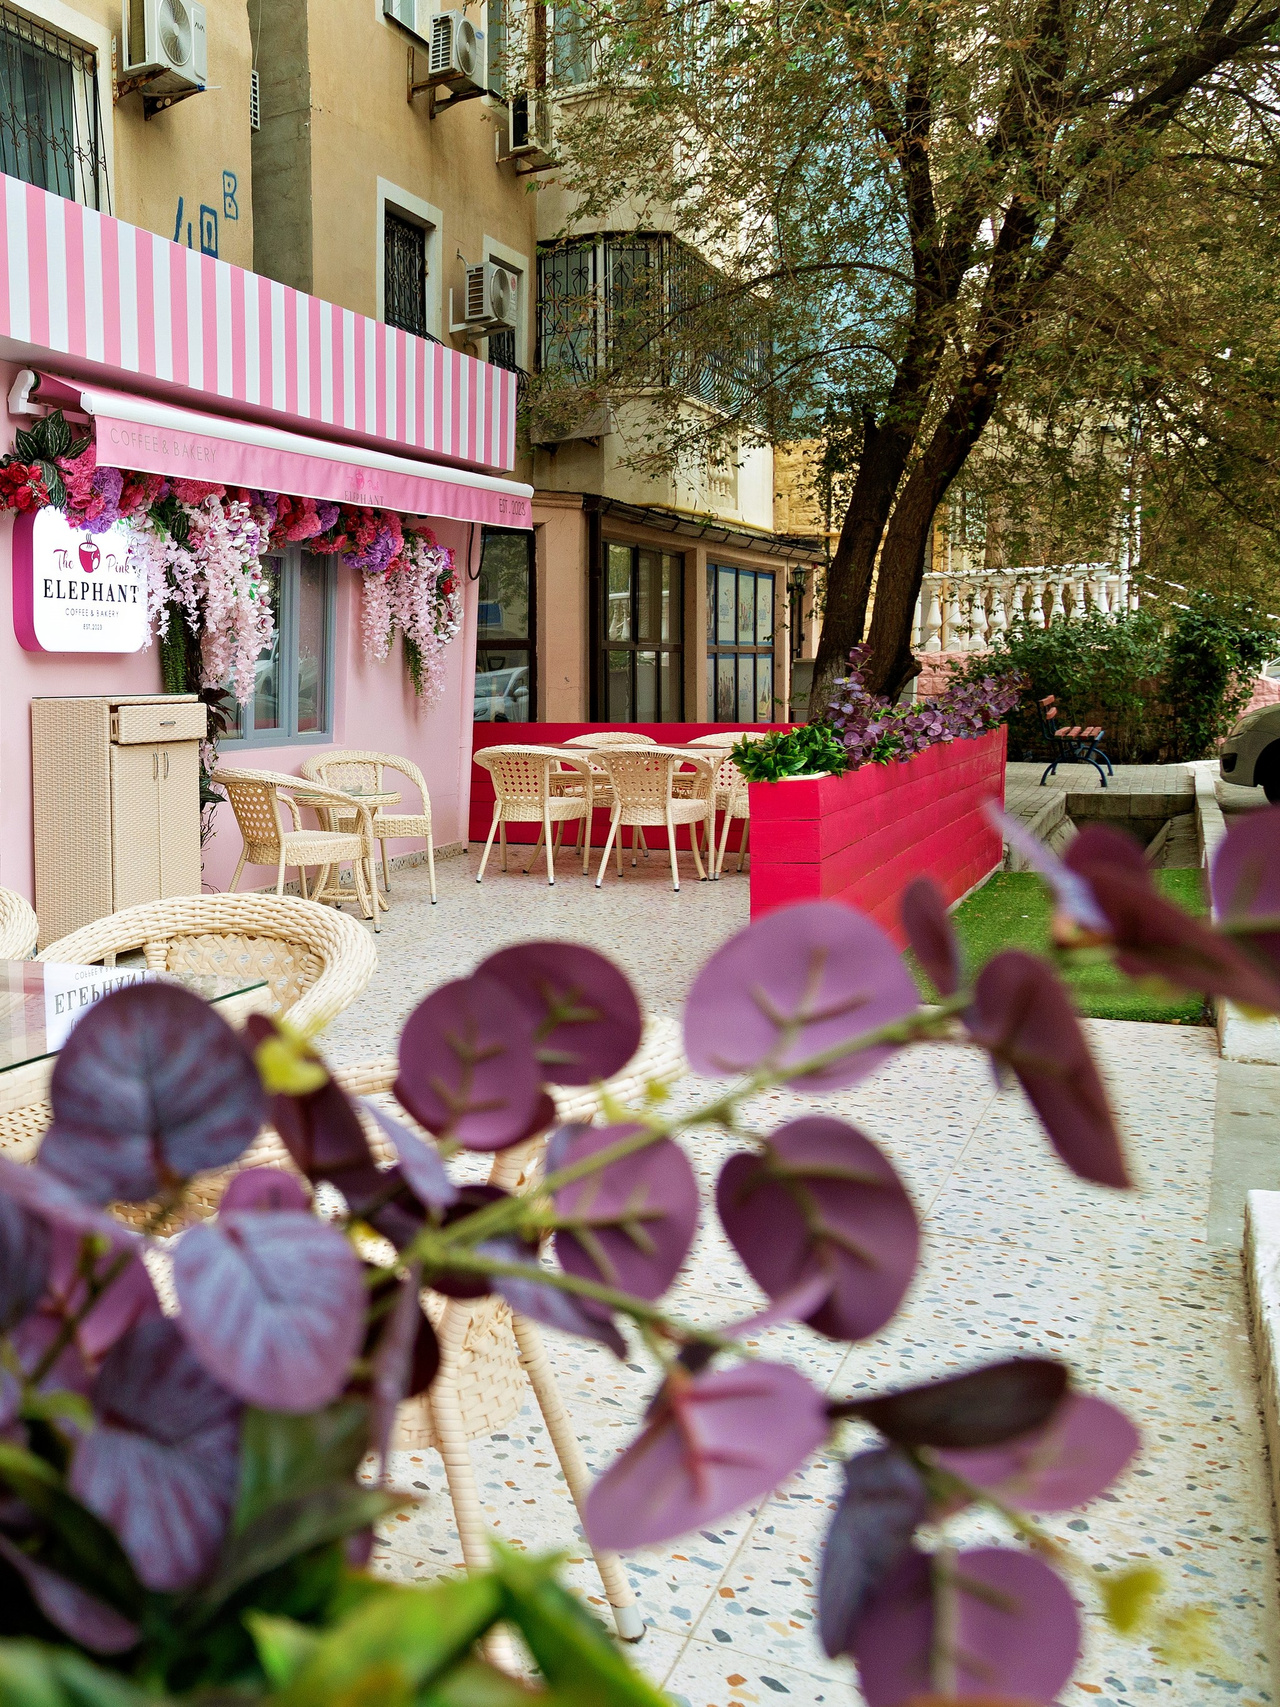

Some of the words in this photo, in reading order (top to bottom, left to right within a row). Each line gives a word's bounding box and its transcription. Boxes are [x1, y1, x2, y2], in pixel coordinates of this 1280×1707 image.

[110, 427, 159, 453] COFFEE
[162, 439, 170, 455] &
[173, 441, 217, 463] BAKERY
[344, 490, 385, 506] ELEPHANT
[512, 500, 526, 516] 2023
[53, 548, 75, 571] The
[105, 553, 131, 574] Pink
[43, 578, 140, 604] ELEPHANT
[65, 607, 89, 617] COFFEE
[90, 609, 95, 617] &
[96, 609, 119, 618] BAKERY
